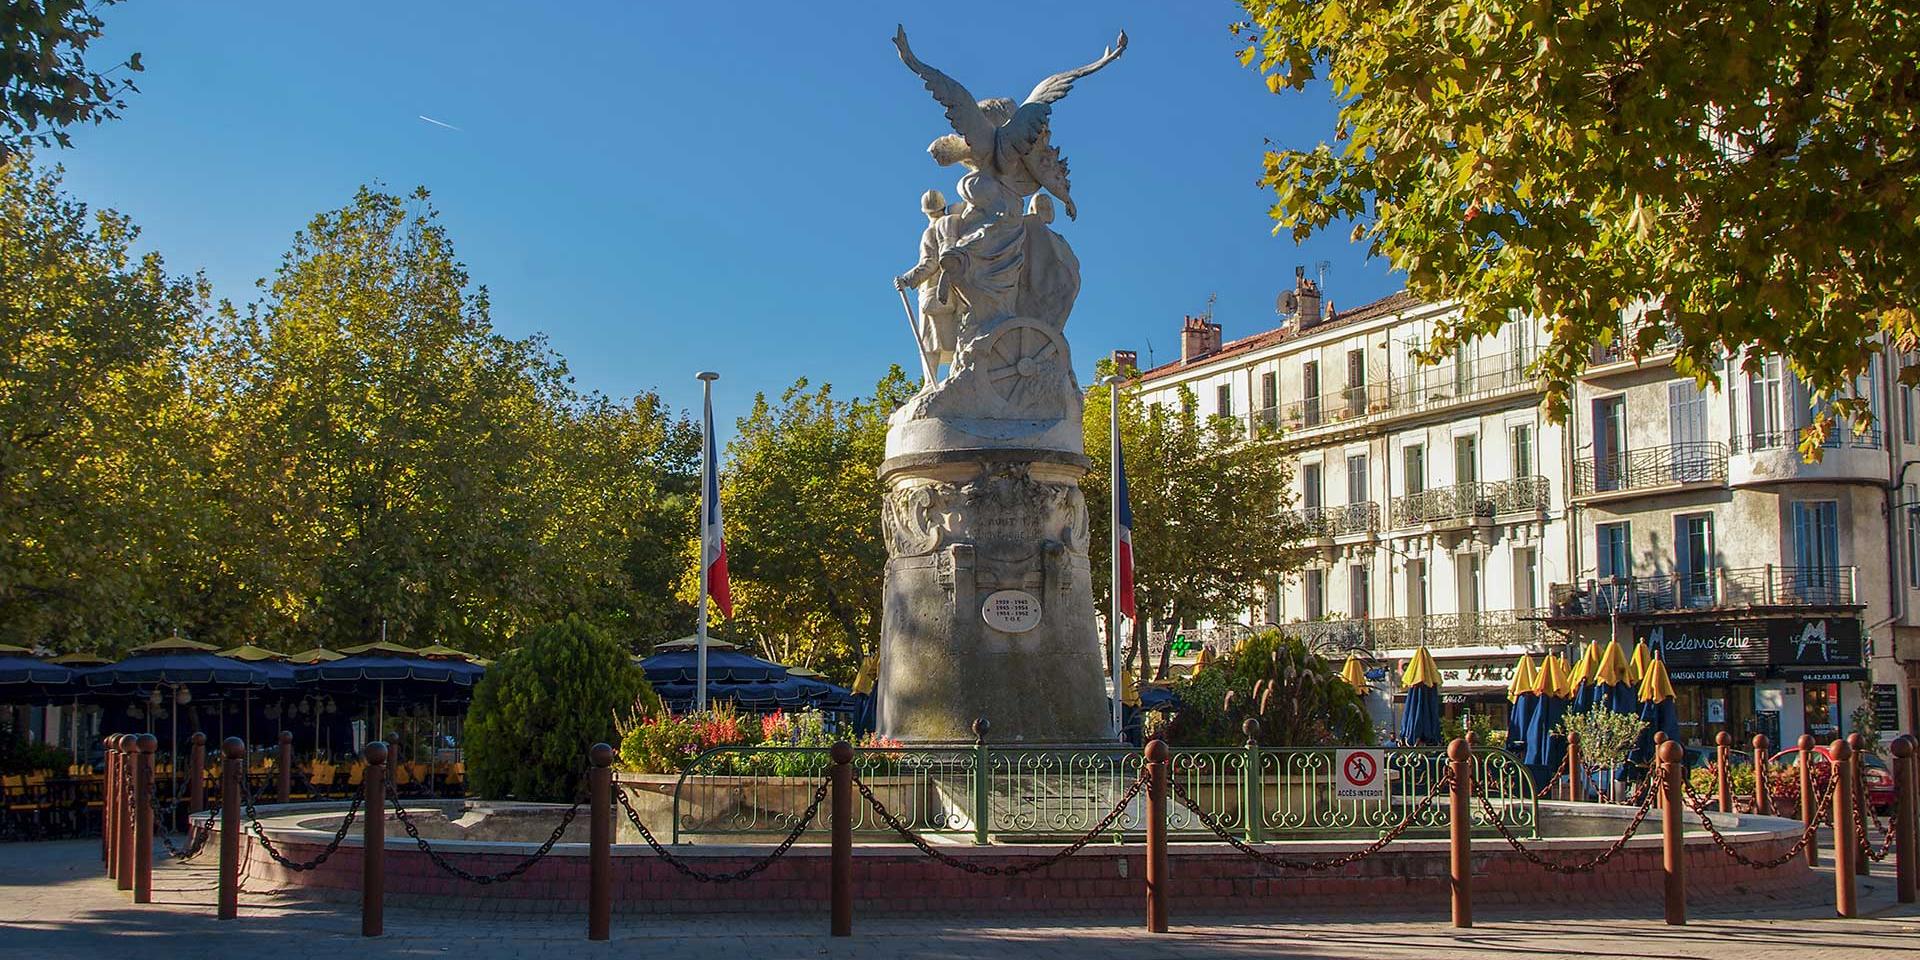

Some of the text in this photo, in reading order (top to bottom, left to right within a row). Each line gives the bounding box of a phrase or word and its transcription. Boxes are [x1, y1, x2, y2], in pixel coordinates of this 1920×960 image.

[1649, 626, 1751, 664] Mademoiselle
[1443, 671, 1459, 680] BAR
[1671, 671, 1696, 680] MAISON
[1697, 671, 1705, 679] DE
